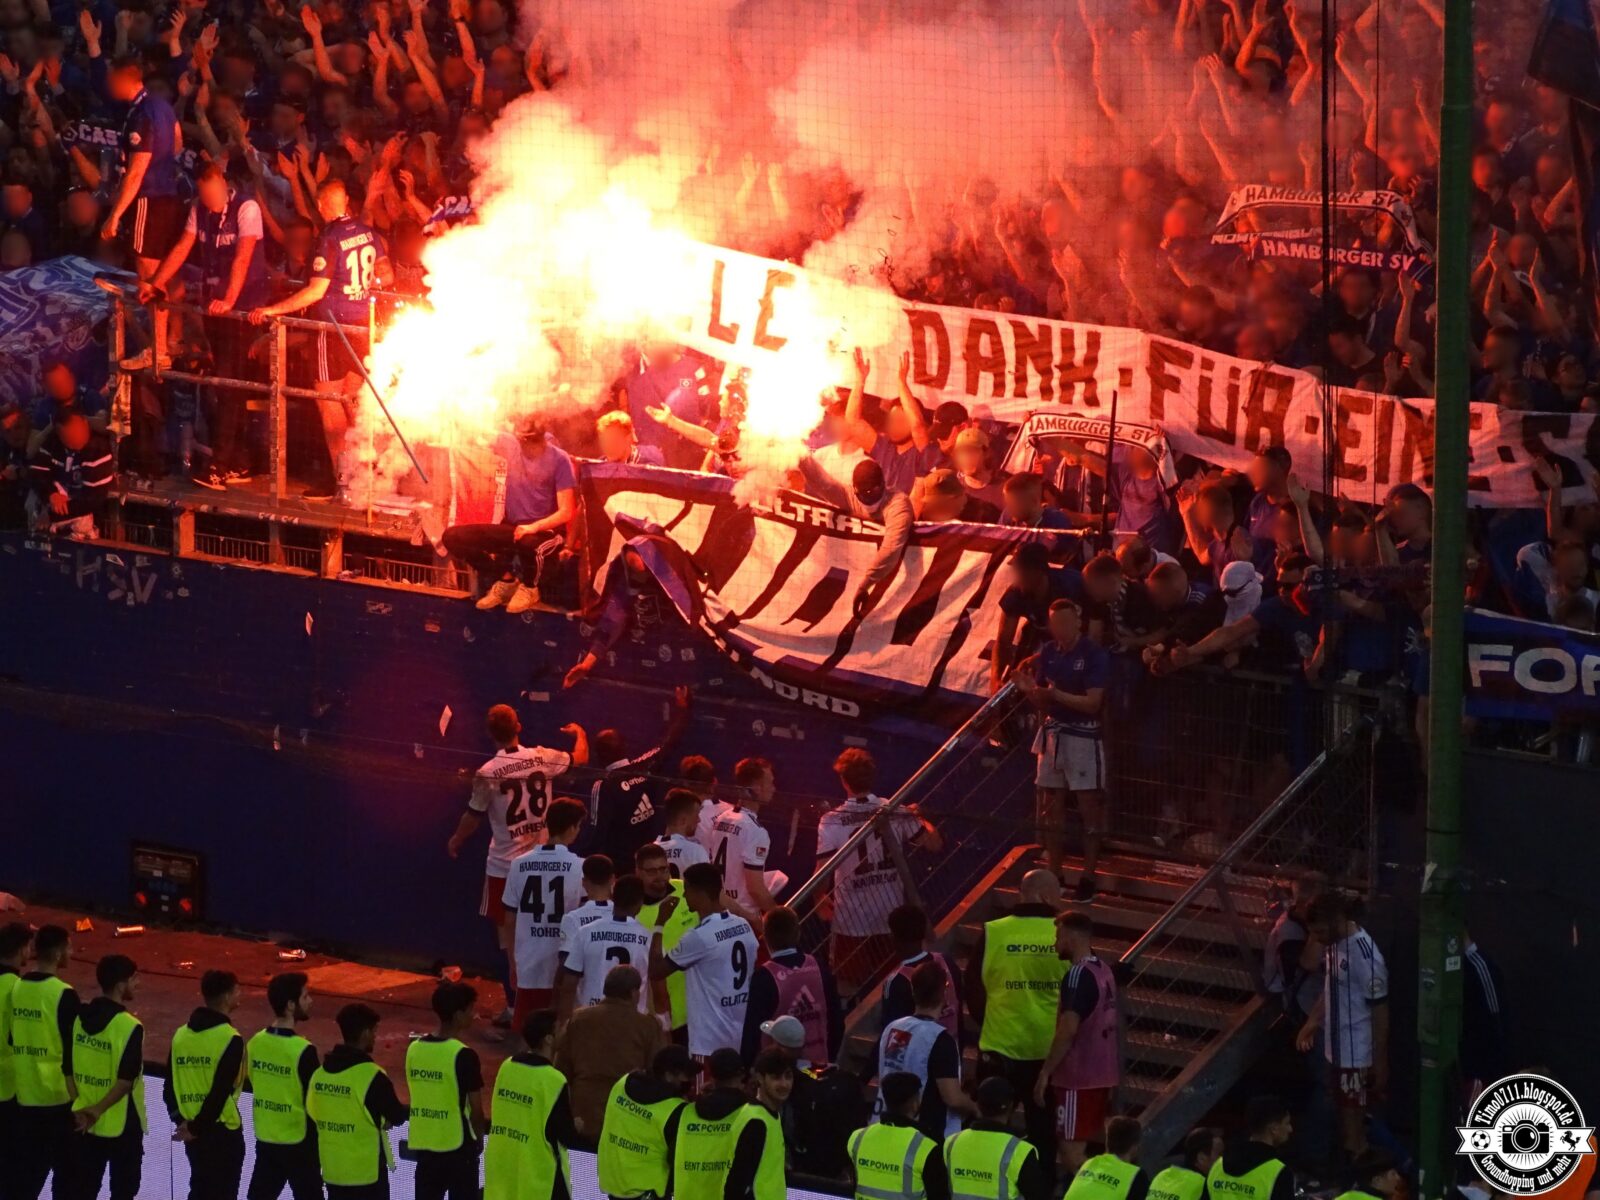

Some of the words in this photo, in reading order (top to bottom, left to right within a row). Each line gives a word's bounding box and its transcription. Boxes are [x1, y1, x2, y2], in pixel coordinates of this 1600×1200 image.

[1371, 192, 1400, 208] SV
[1262, 240, 1383, 267] HAMBRGER
[1389, 254, 1416, 271] SV
[343, 245, 376, 295] 18
[903, 309, 1101, 407] DANK
[1147, 341, 1295, 454] FÜR
[493, 757, 535, 778] HAMBURGER
[500, 771, 547, 826] 28
[520, 861, 561, 873] HAMBURGER
[562, 863, 572, 873] SV
[520, 875, 565, 924] 41
[530, 927, 561, 938] ROHR
[591, 931, 636, 943] HAMBURGER
[637, 936, 648, 946] SV
[1022, 945, 1056, 953] POWE
[731, 940, 748, 990] 9
[1005, 981, 1026, 990] EVENT
[721, 992, 749, 1007] GLATZ
[86, 1037, 112, 1052] POWER
[186, 1056, 211, 1065] POWER
[262, 1060, 291, 1075] POWER
[413, 1069, 443, 1080] POWER
[324, 1083, 351, 1095] POWER
[505, 1090, 533, 1105] POWER
[265, 1099, 292, 1112] SECURITY
[421, 1107, 448, 1119] SECURITY
[625, 1101, 653, 1120] POWER
[327, 1121, 355, 1133] SECURITY
[701, 1123, 731, 1133] POWER
[618, 1138, 649, 1155] SECURITY
[870, 1160, 900, 1172] POWER
[966, 1169, 993, 1180] POWER
[1224, 1181, 1255, 1195] POWER
